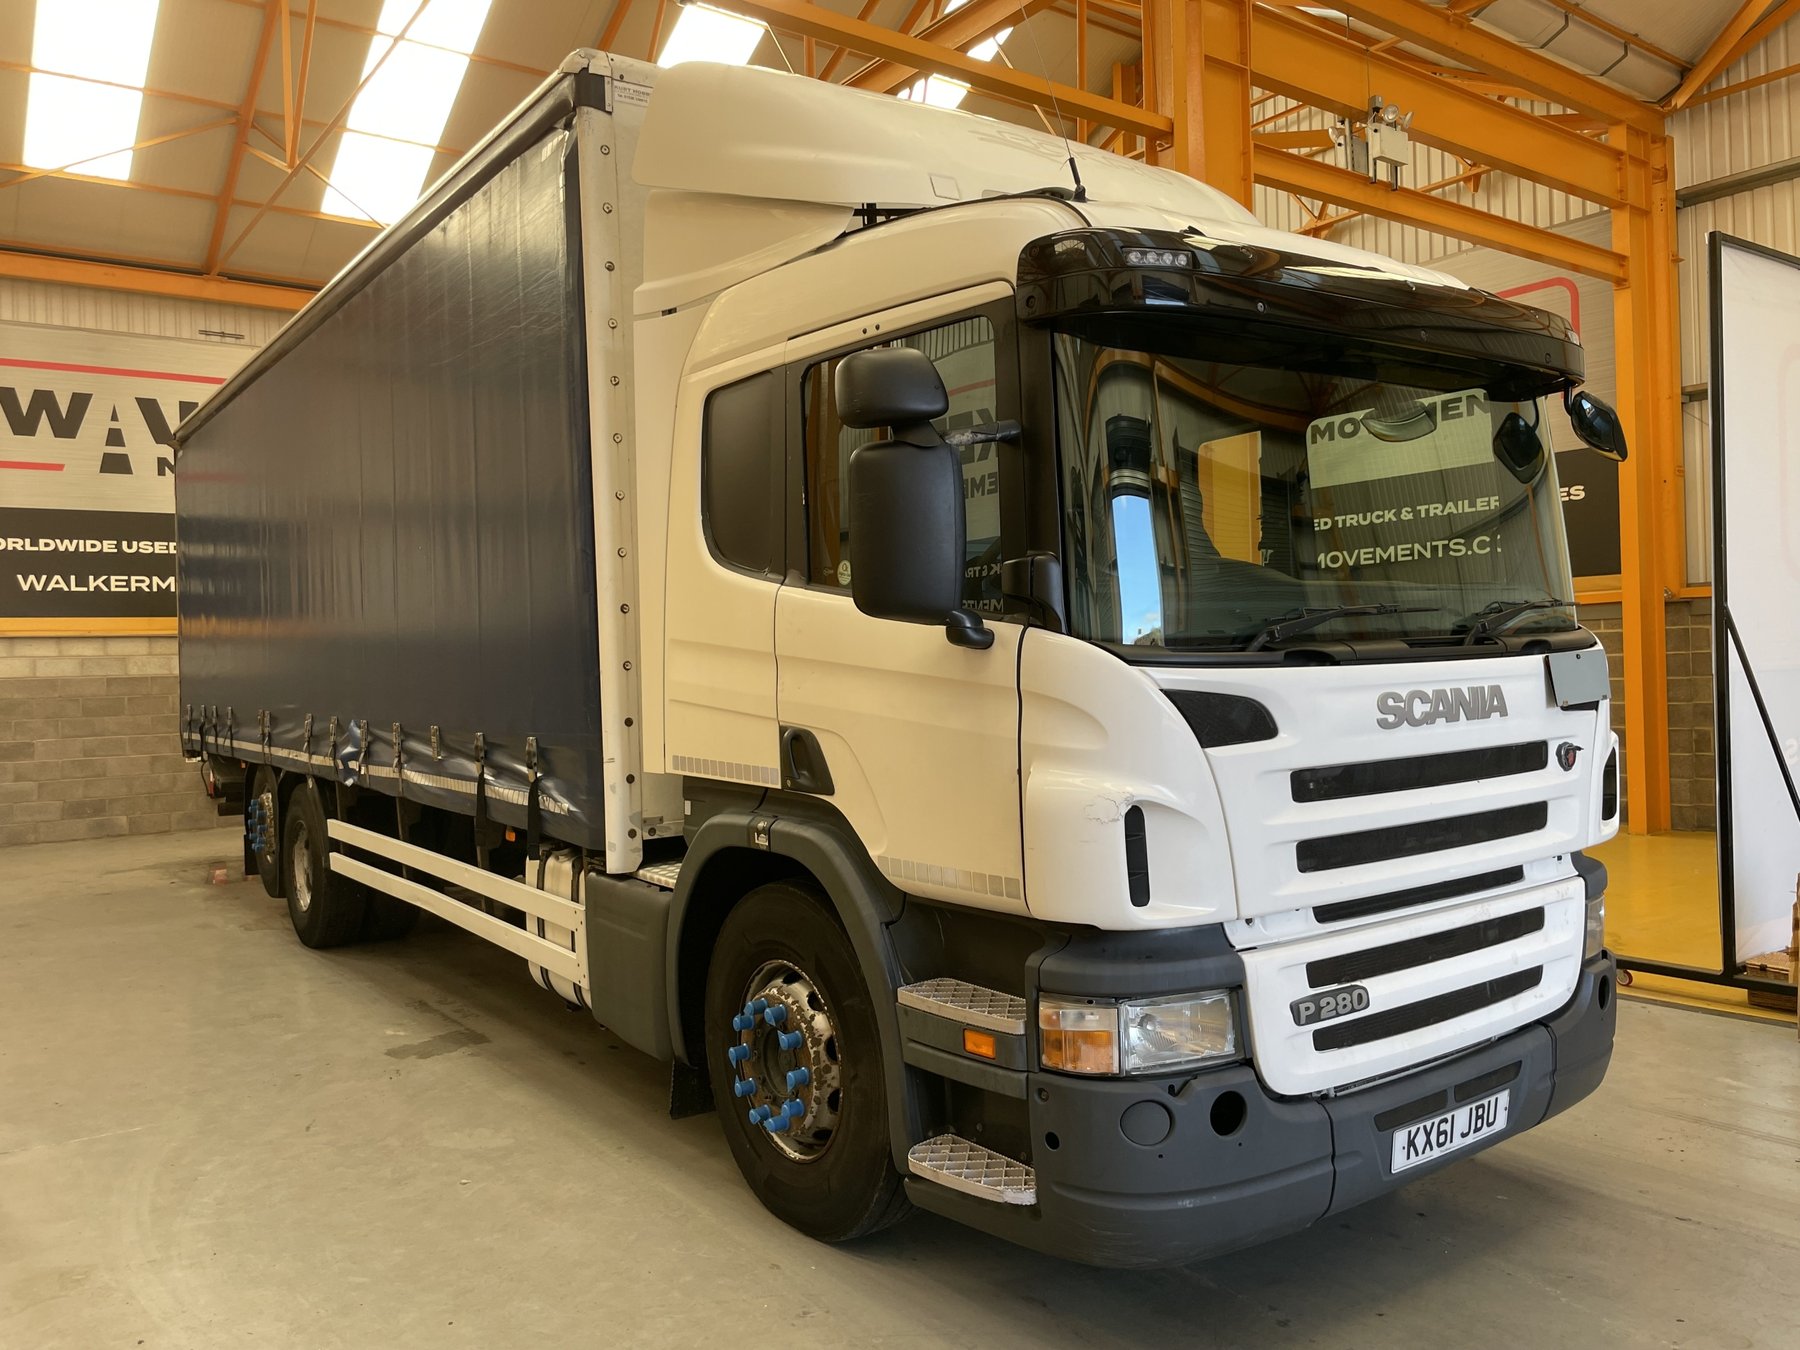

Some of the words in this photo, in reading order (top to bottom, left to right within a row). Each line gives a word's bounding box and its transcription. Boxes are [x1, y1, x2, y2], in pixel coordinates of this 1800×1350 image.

[1335, 509, 1397, 528] TRUCK
[1400, 507, 1413, 520] &
[16, 574, 176, 592] WALKERM
[1376, 684, 1508, 730] SCANIA
[1298, 1001, 1316, 1025] P
[1319, 988, 1368, 1019] 280
[1406, 1113, 1456, 1161] KX61
[1460, 1096, 1499, 1139] JBU
